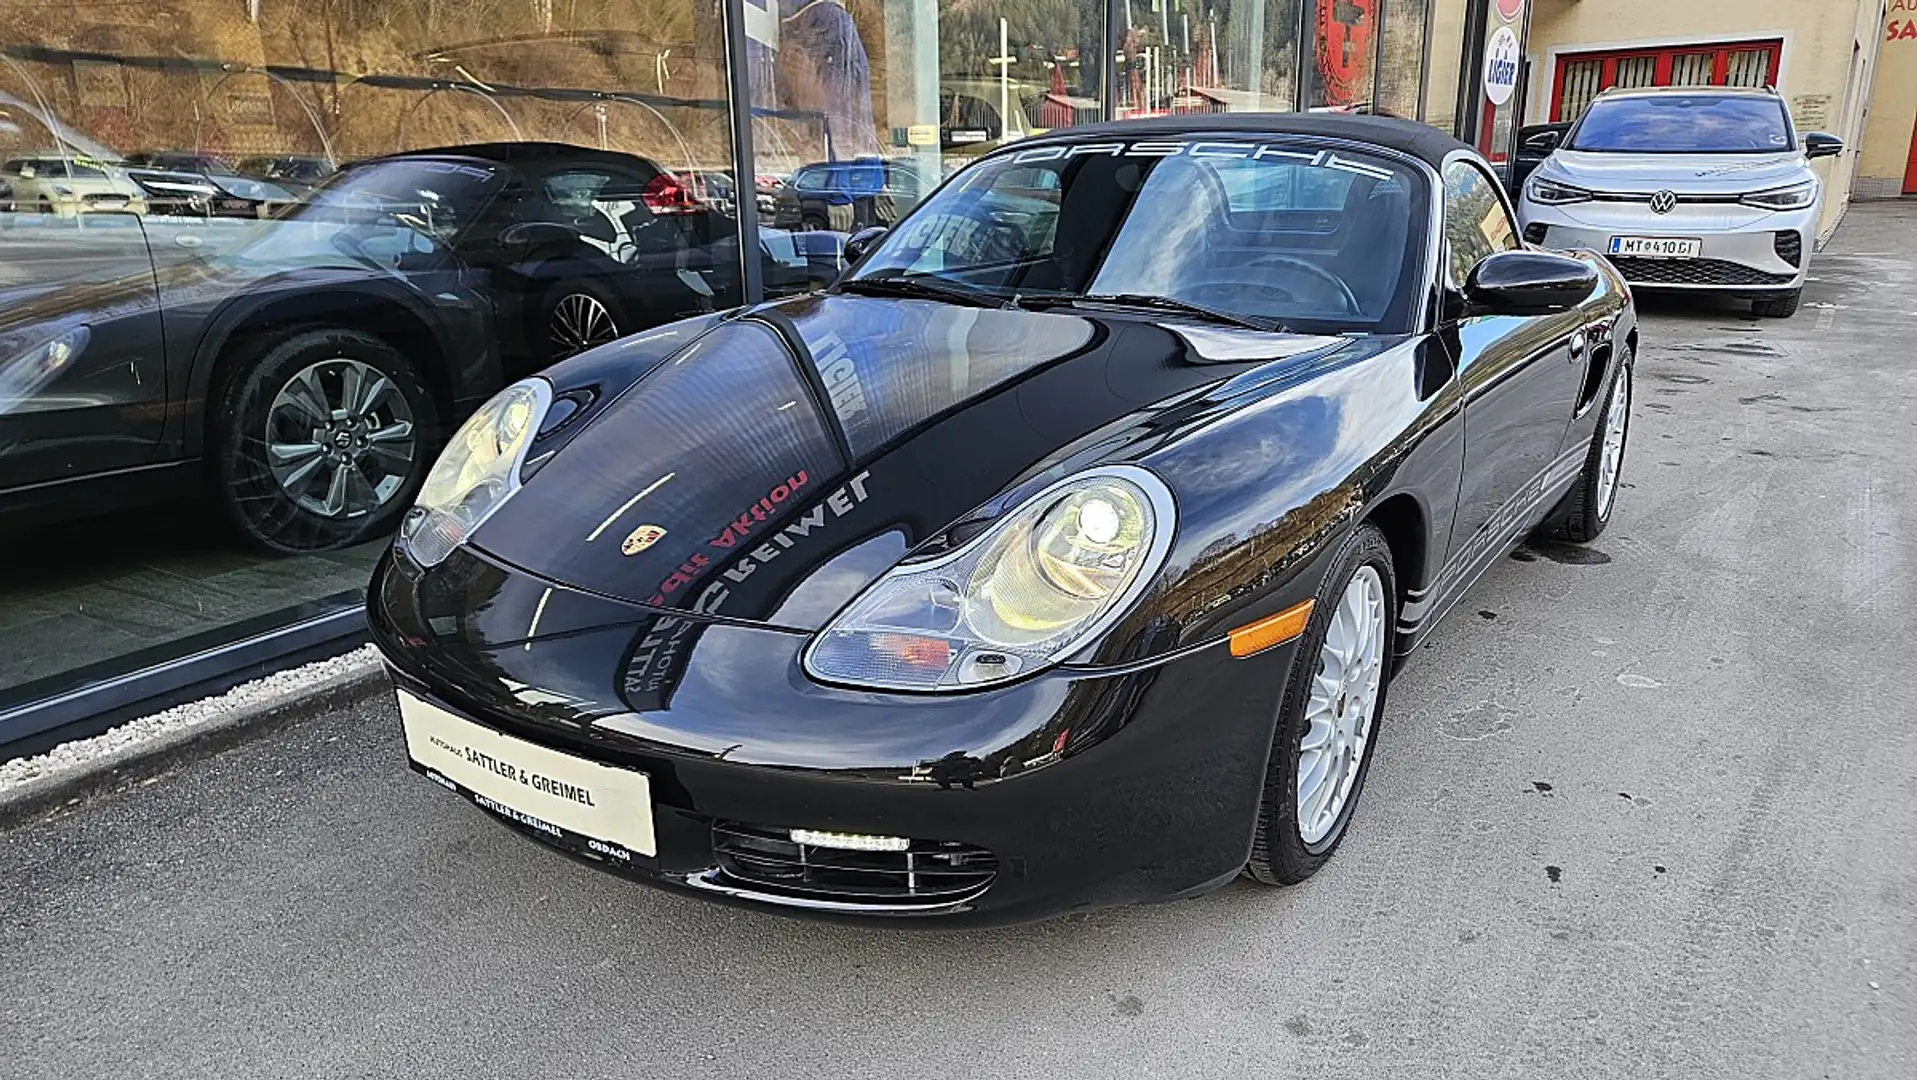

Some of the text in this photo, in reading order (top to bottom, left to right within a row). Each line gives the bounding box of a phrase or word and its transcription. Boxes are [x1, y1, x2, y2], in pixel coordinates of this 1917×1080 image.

[976, 141, 1395, 181] PORSCHE
[465, 746, 517, 781] SATTLER
[519, 769, 529, 785] &
[531, 773, 596, 808] GREIMEL
[474, 793, 512, 817] SATTLER
[520, 813, 563, 838] GREIMEL
